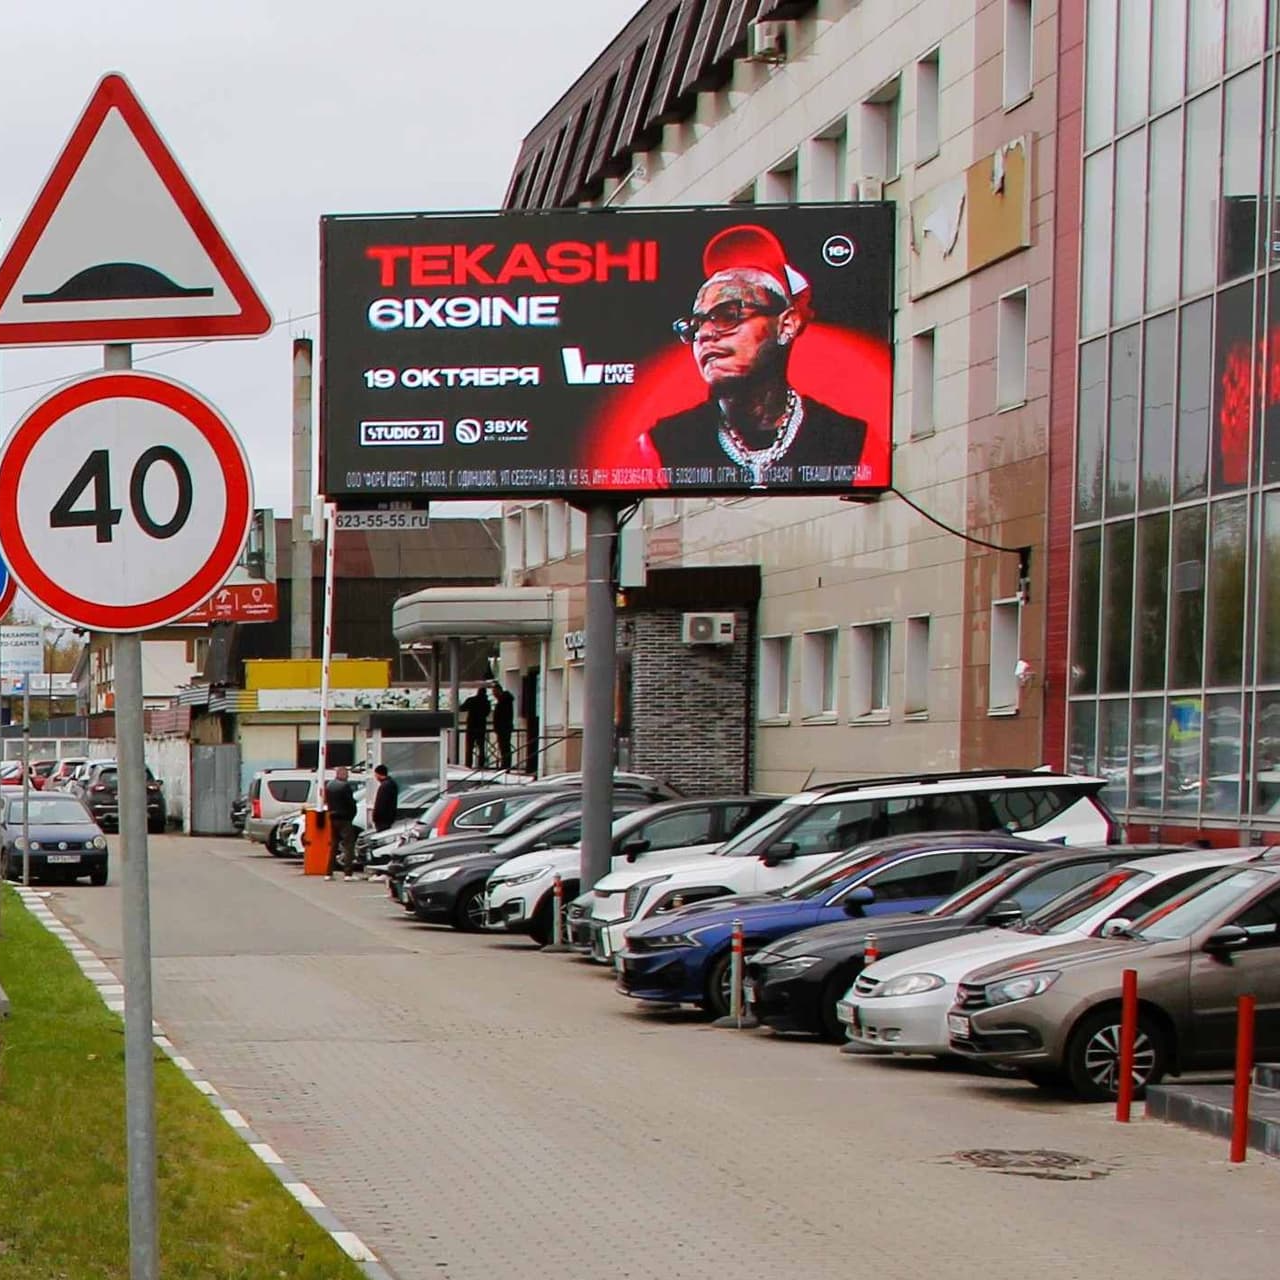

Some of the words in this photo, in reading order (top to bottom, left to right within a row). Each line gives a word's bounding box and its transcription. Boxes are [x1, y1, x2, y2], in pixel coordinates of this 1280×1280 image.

[366, 240, 658, 287] TEKASHI
[368, 295, 561, 330] 6IX9INE
[364, 369, 395, 388] 19
[401, 366, 540, 387] ОКТЯБРЯ
[604, 374, 634, 383] LIVE
[367, 427, 420, 440] STUDIO
[422, 427, 437, 438] 21
[484, 420, 528, 433] ЗВУК
[49, 445, 193, 543] 40
